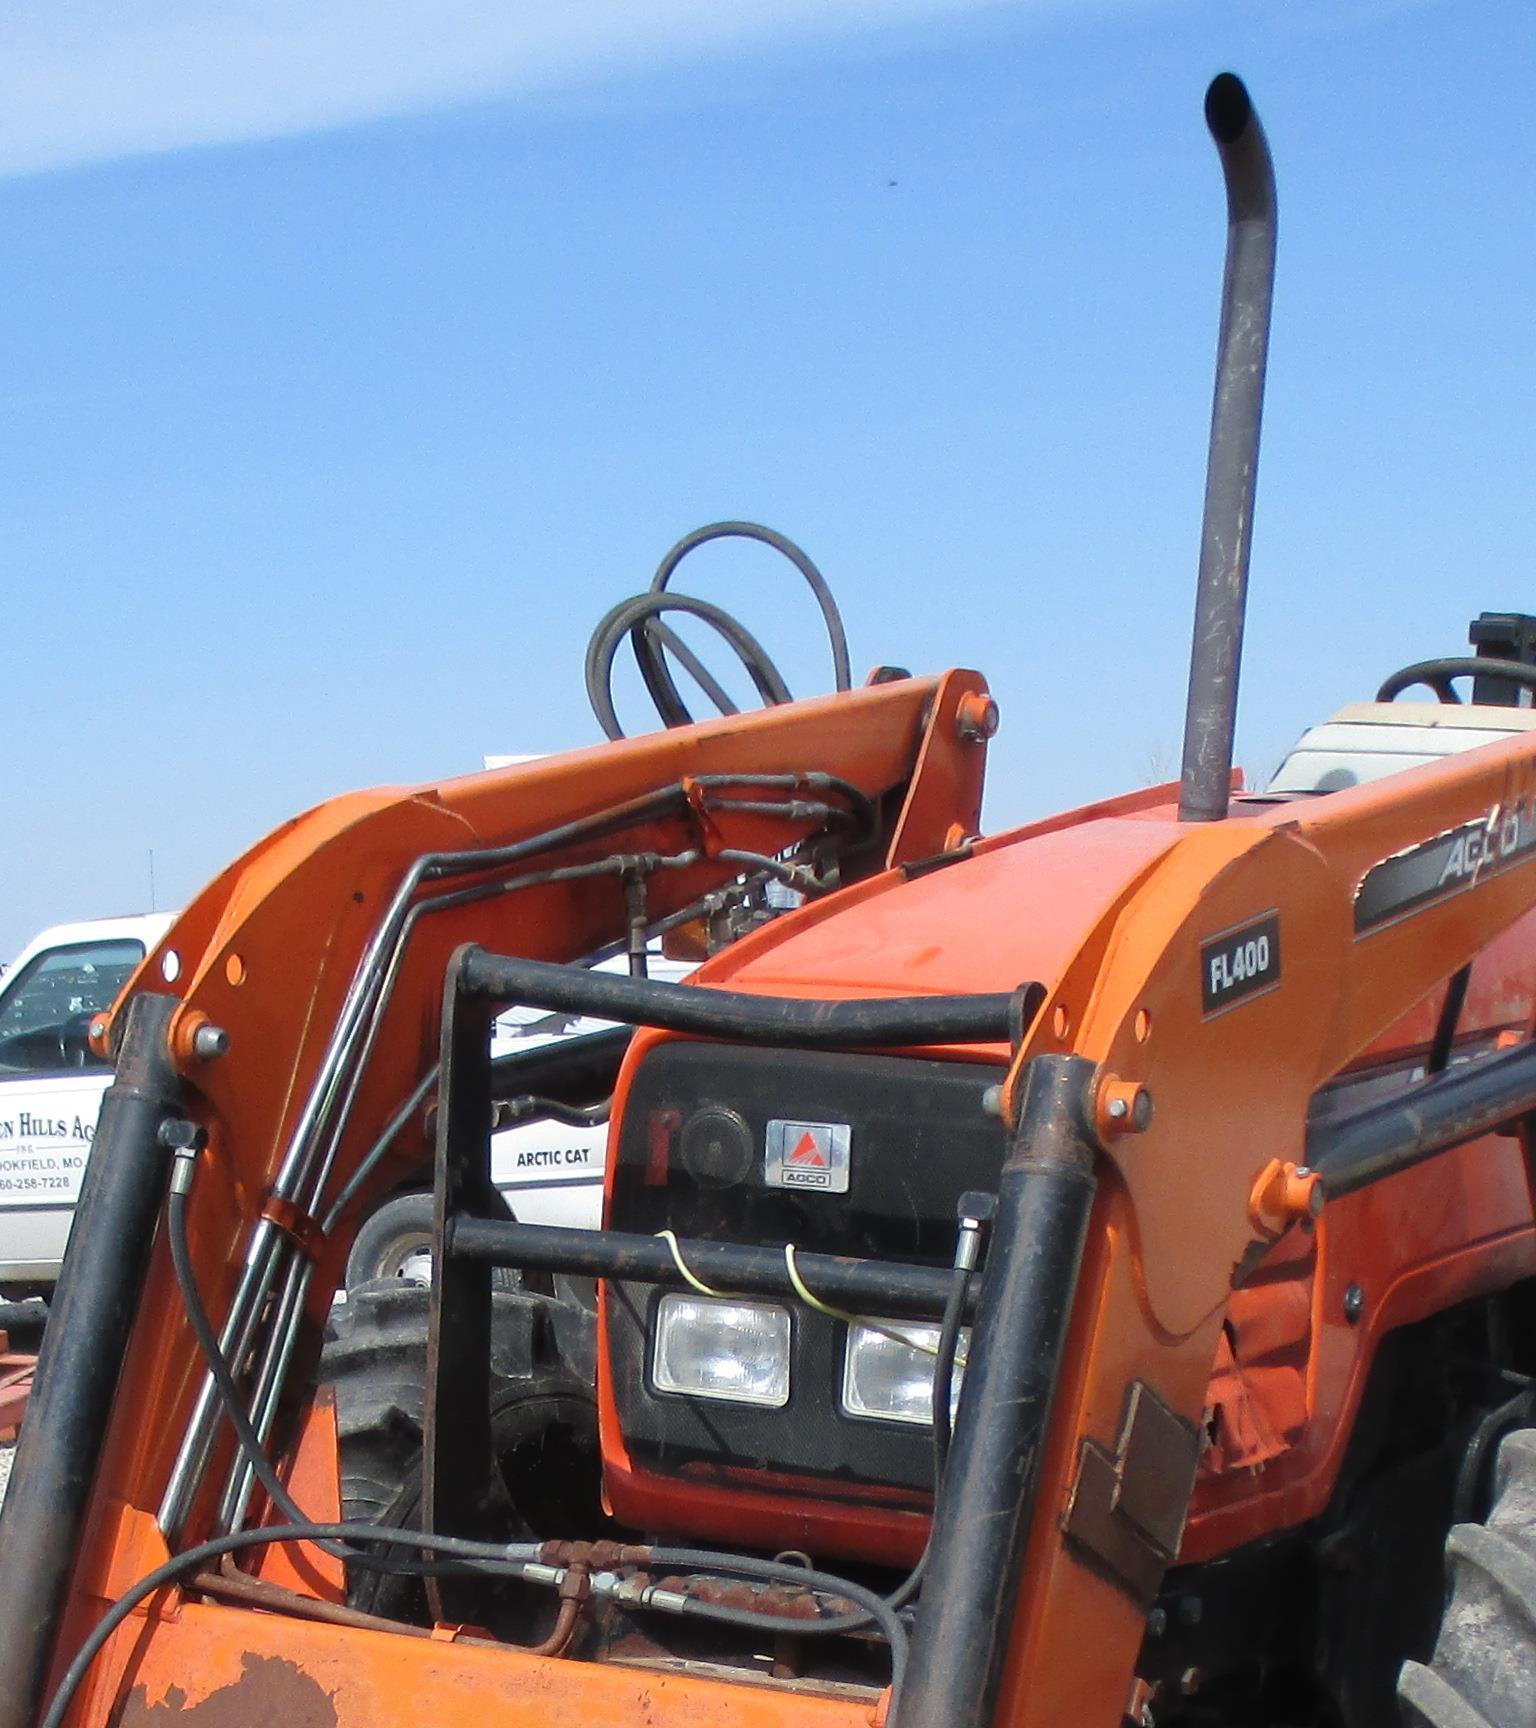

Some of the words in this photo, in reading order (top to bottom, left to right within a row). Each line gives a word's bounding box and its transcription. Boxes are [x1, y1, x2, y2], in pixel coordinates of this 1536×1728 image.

[1211, 935, 1269, 994] FL400
[19, 1112, 67, 1138] HILLS
[517, 1150, 562, 1167] ARCTIC
[565, 1148, 590, 1164] CAT
[786, 1173, 827, 1185] AGCO
